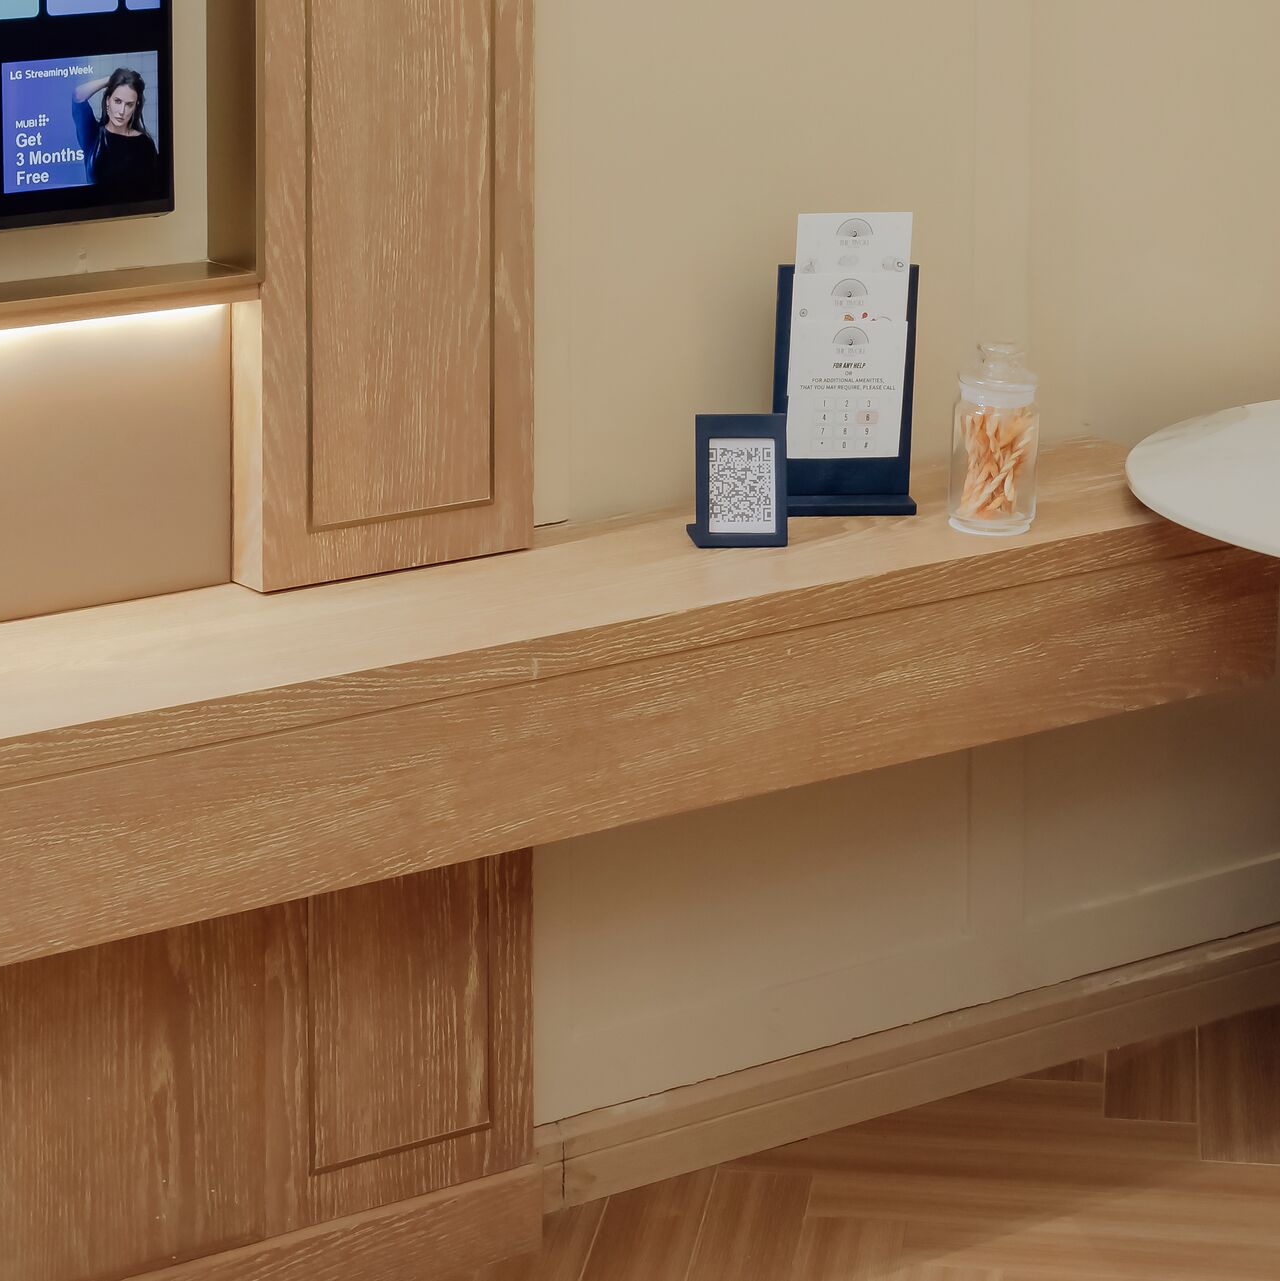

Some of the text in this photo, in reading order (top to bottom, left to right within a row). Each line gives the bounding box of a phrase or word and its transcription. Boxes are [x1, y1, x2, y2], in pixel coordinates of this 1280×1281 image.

[10, 65, 93, 80] LG Streaming Week
[15, 119, 38, 129] MUBI
[16, 132, 42, 148] Get
[16, 148, 85, 166] 3 Months
[16, 171, 50, 186] Free
[821, 427, 825, 435] 7
